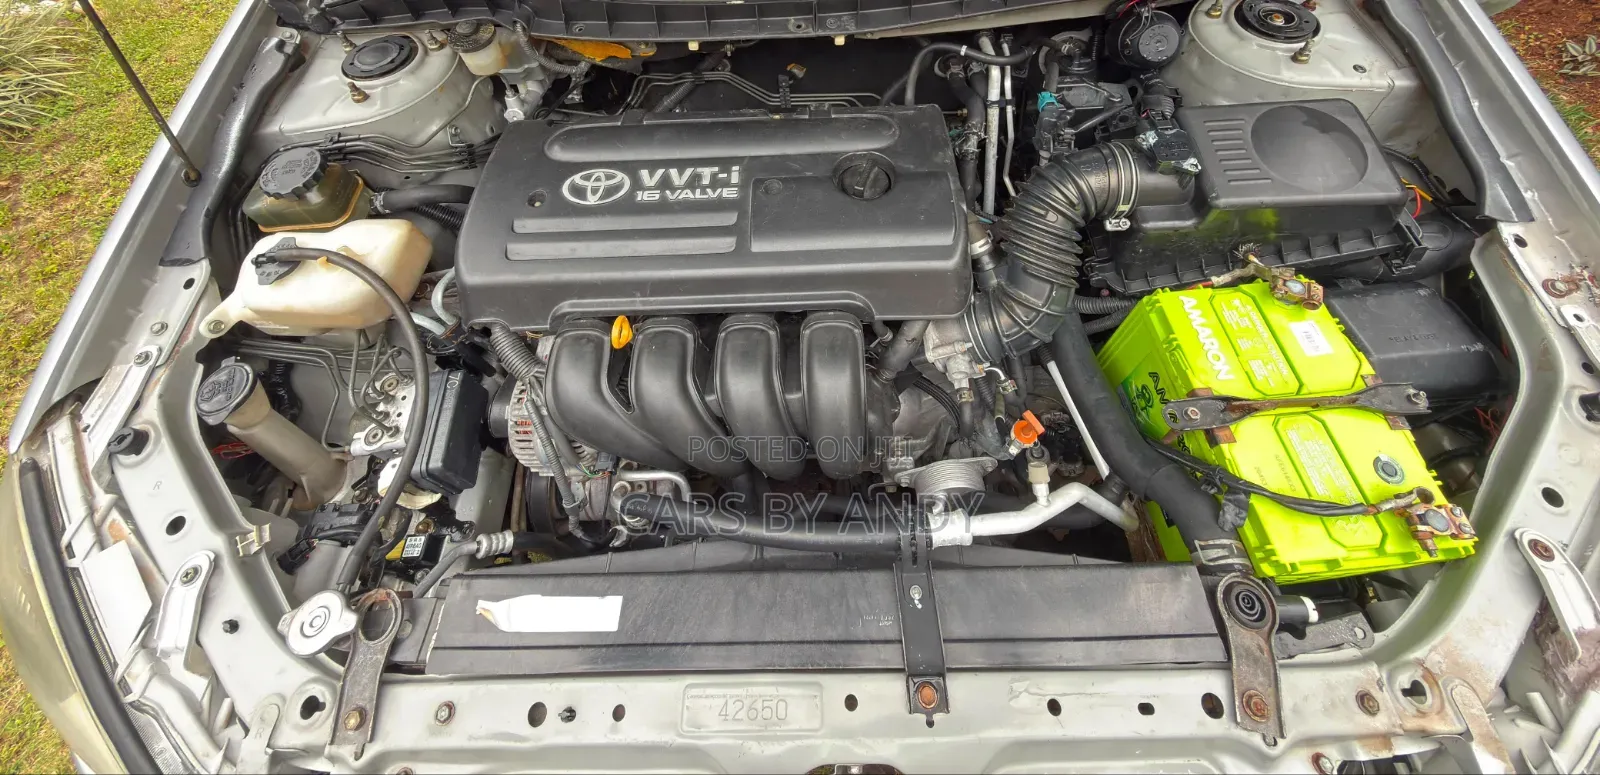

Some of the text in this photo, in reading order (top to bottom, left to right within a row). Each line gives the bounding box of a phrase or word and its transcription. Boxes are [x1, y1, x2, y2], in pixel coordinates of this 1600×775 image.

[639, 166, 740, 187] VVT-i
[636, 188, 739, 201] 16 VALVE
[1179, 295, 1237, 381] AMARON
[718, 698, 789, 722] 42650
